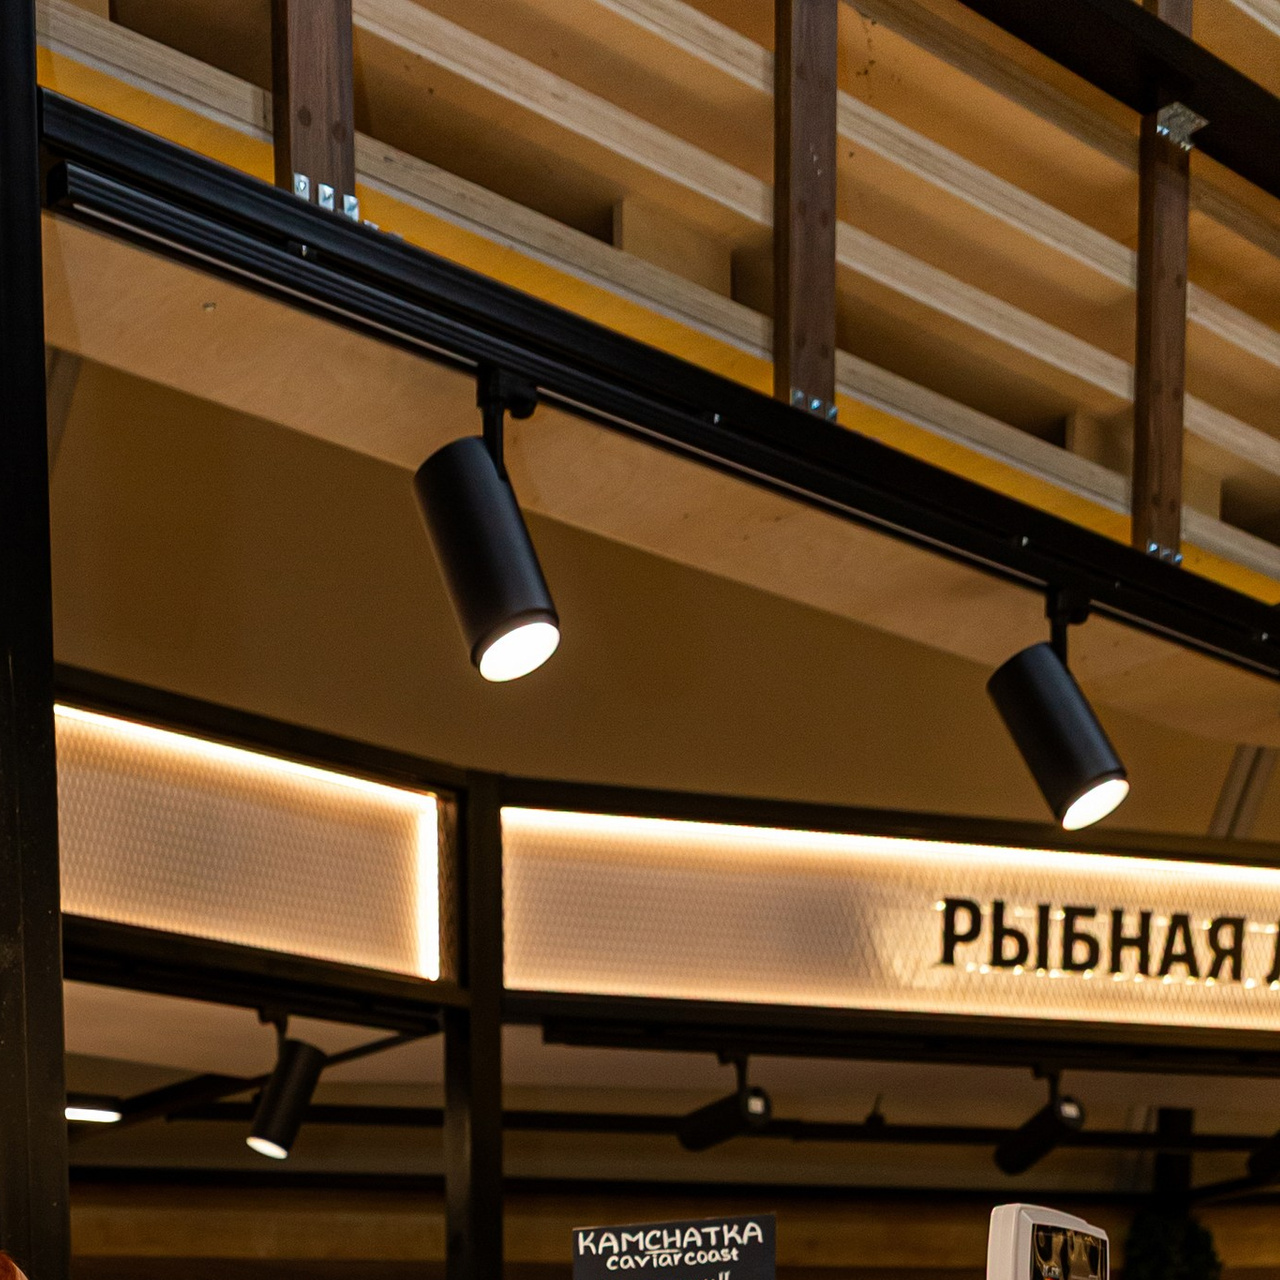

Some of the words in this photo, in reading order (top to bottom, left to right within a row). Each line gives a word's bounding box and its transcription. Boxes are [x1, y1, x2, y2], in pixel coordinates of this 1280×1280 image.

[941, 897, 1246, 981] РЫБНАЯ
[578, 1222, 764, 1255] KAMCHATKA
[684, 1247, 739, 1265] coast
